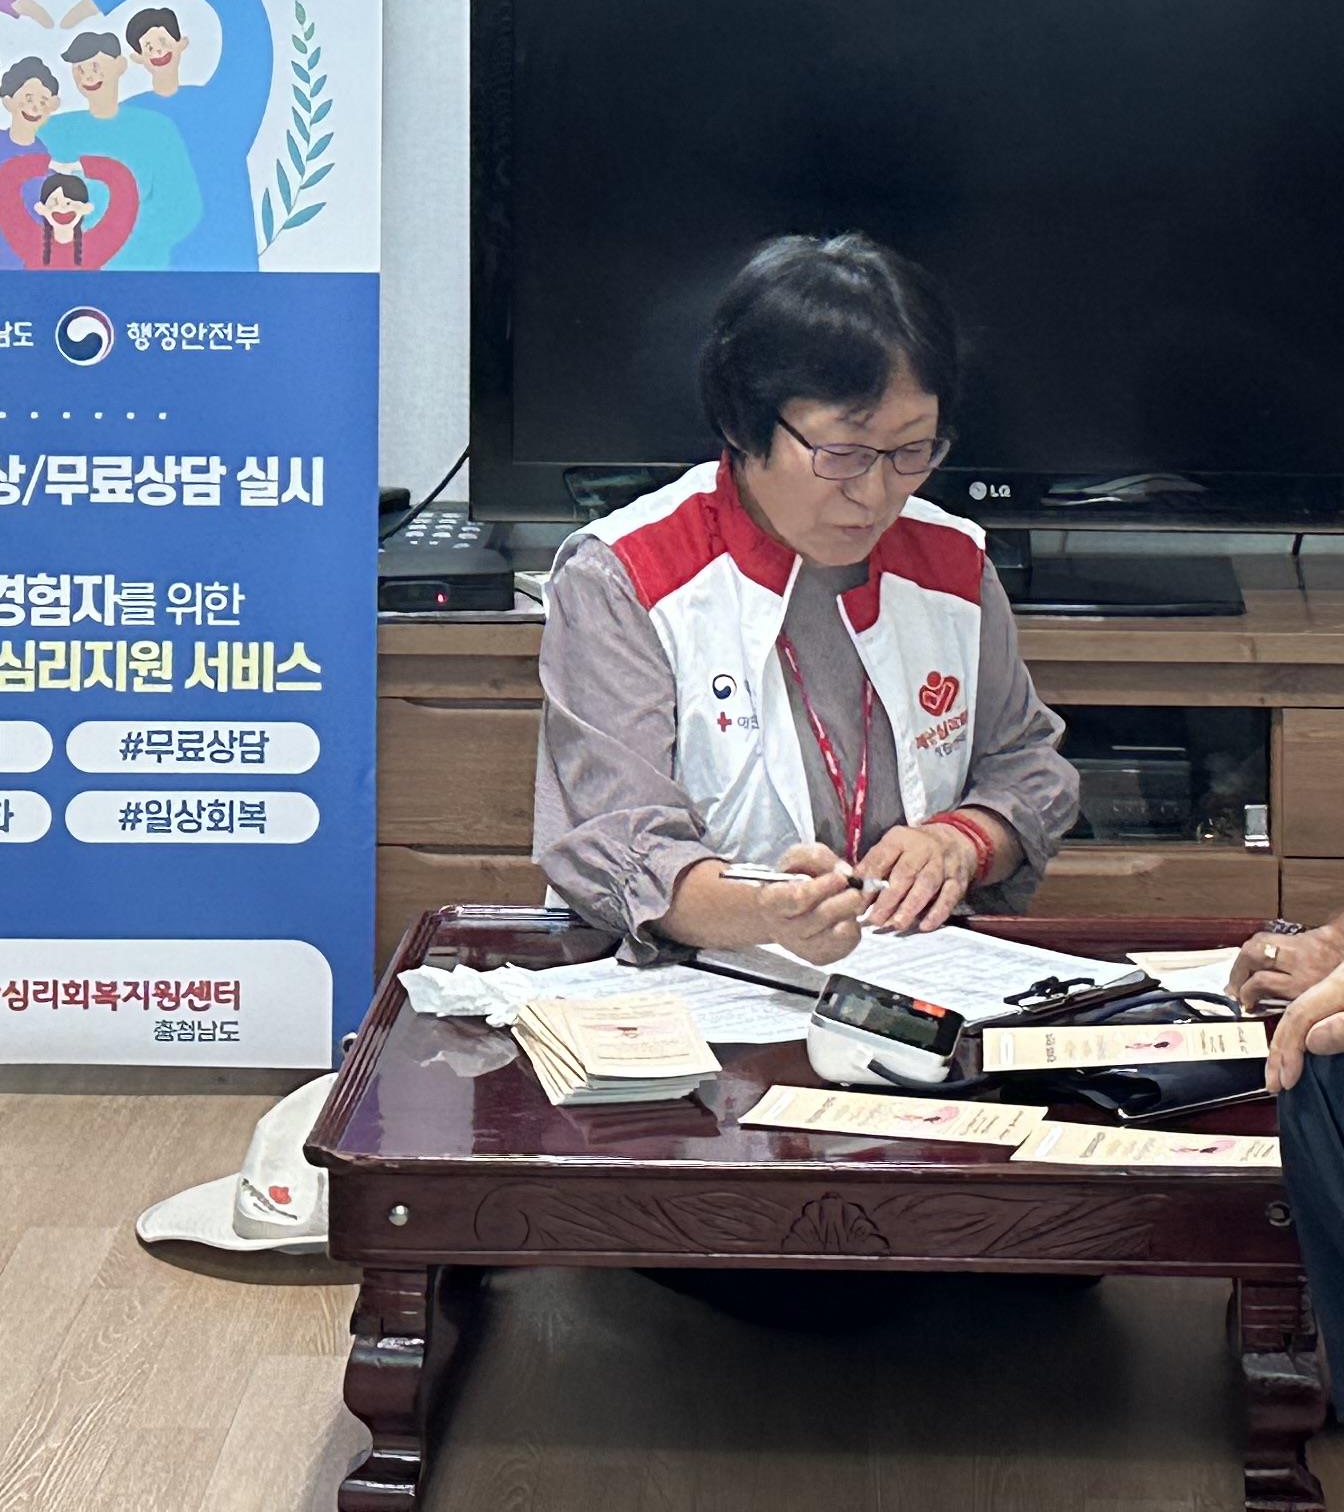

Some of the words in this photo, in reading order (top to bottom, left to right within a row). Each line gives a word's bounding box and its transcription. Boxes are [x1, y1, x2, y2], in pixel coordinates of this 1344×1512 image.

[126, 321, 260, 352] 행정안전부
[236, 456, 324, 506] 실시
[166, 581, 245, 626] 위한
[186, 641, 322, 693] 서비스
[120, 730, 269, 765] #무료상담
[119, 799, 267, 835] #일상회복
[153, 1020, 242, 1043] 충청남도
